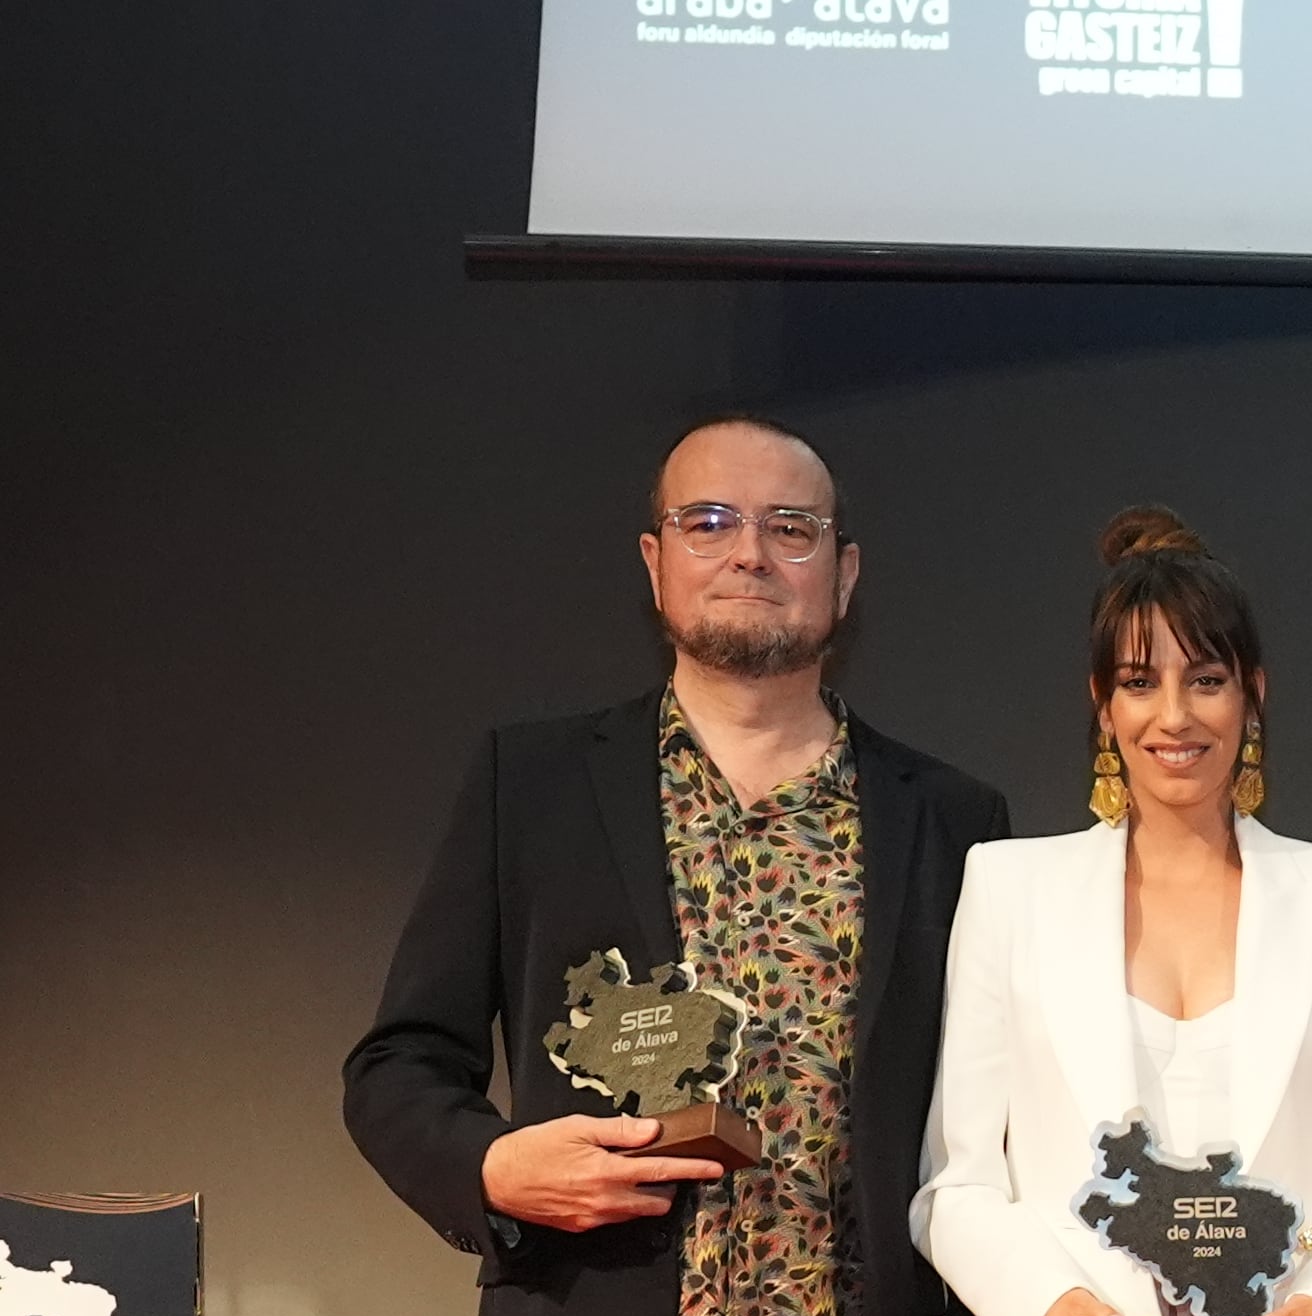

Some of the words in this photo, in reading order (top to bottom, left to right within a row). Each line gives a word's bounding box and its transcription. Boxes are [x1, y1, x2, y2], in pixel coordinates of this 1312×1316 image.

[637, 22, 680, 42] foru
[684, 25, 775, 45] aldundia
[785, 27, 897, 50] diputación
[901, 31, 950, 50] foral
[1025, 10, 1201, 64] GASTEIZ
[619, 1005, 673, 1033] SER
[612, 1038, 630, 1054] de
[635, 1029, 679, 1049] Álava
[1173, 1196, 1238, 1219] SER
[1167, 1225, 1190, 1241] de
[1195, 1220, 1246, 1240] Álava
[1193, 1247, 1222, 1257] 2024
